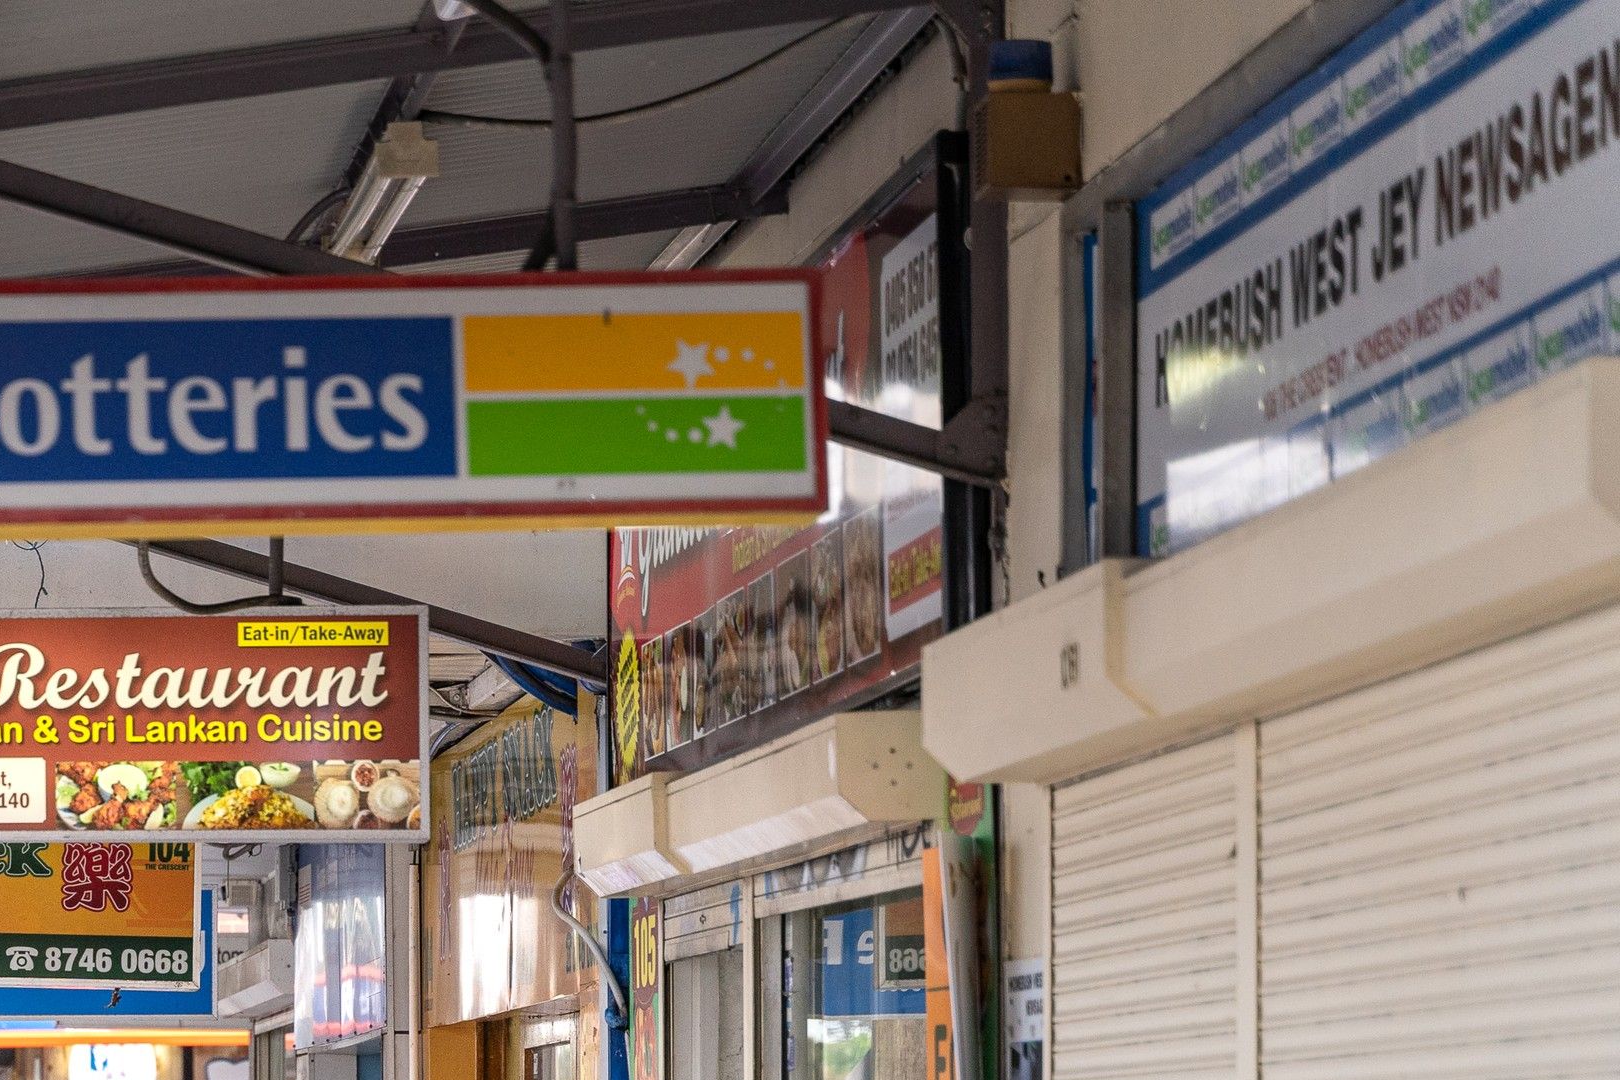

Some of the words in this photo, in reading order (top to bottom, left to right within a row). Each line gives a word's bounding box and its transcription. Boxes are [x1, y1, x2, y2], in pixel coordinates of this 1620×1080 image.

[1289, 206, 1363, 328] WEST
[1372, 167, 1425, 283] JEY
[243, 625, 384, 643] Eat-in/Take-Away
[33, 716, 59, 743] &
[69, 715, 115, 743] Sri
[125, 715, 248, 742] Lankan
[257, 714, 383, 742] Cuisine
[44, 947, 111, 972] 8746
[121, 949, 188, 974] 0668
[634, 914, 657, 988] 105
